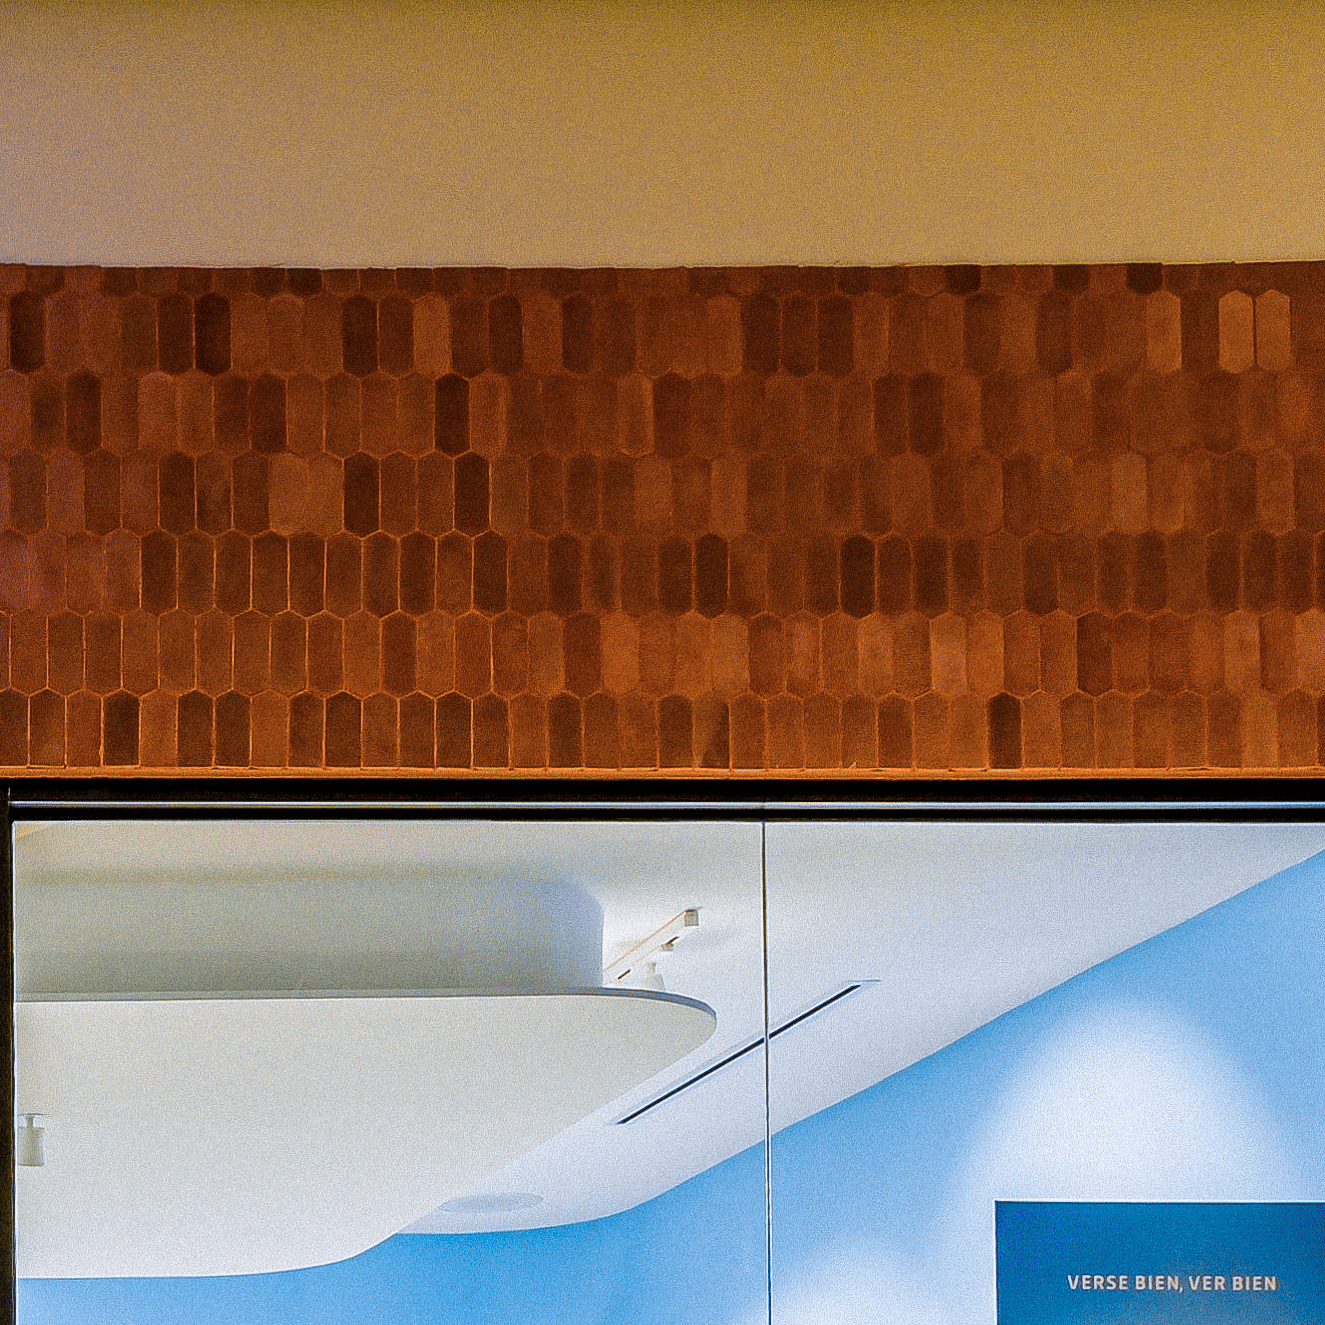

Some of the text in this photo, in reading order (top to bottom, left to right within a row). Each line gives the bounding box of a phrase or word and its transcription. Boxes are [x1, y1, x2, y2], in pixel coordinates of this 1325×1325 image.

[1067, 1275, 1278, 1293] VERSE BIEN, VER BIEN
